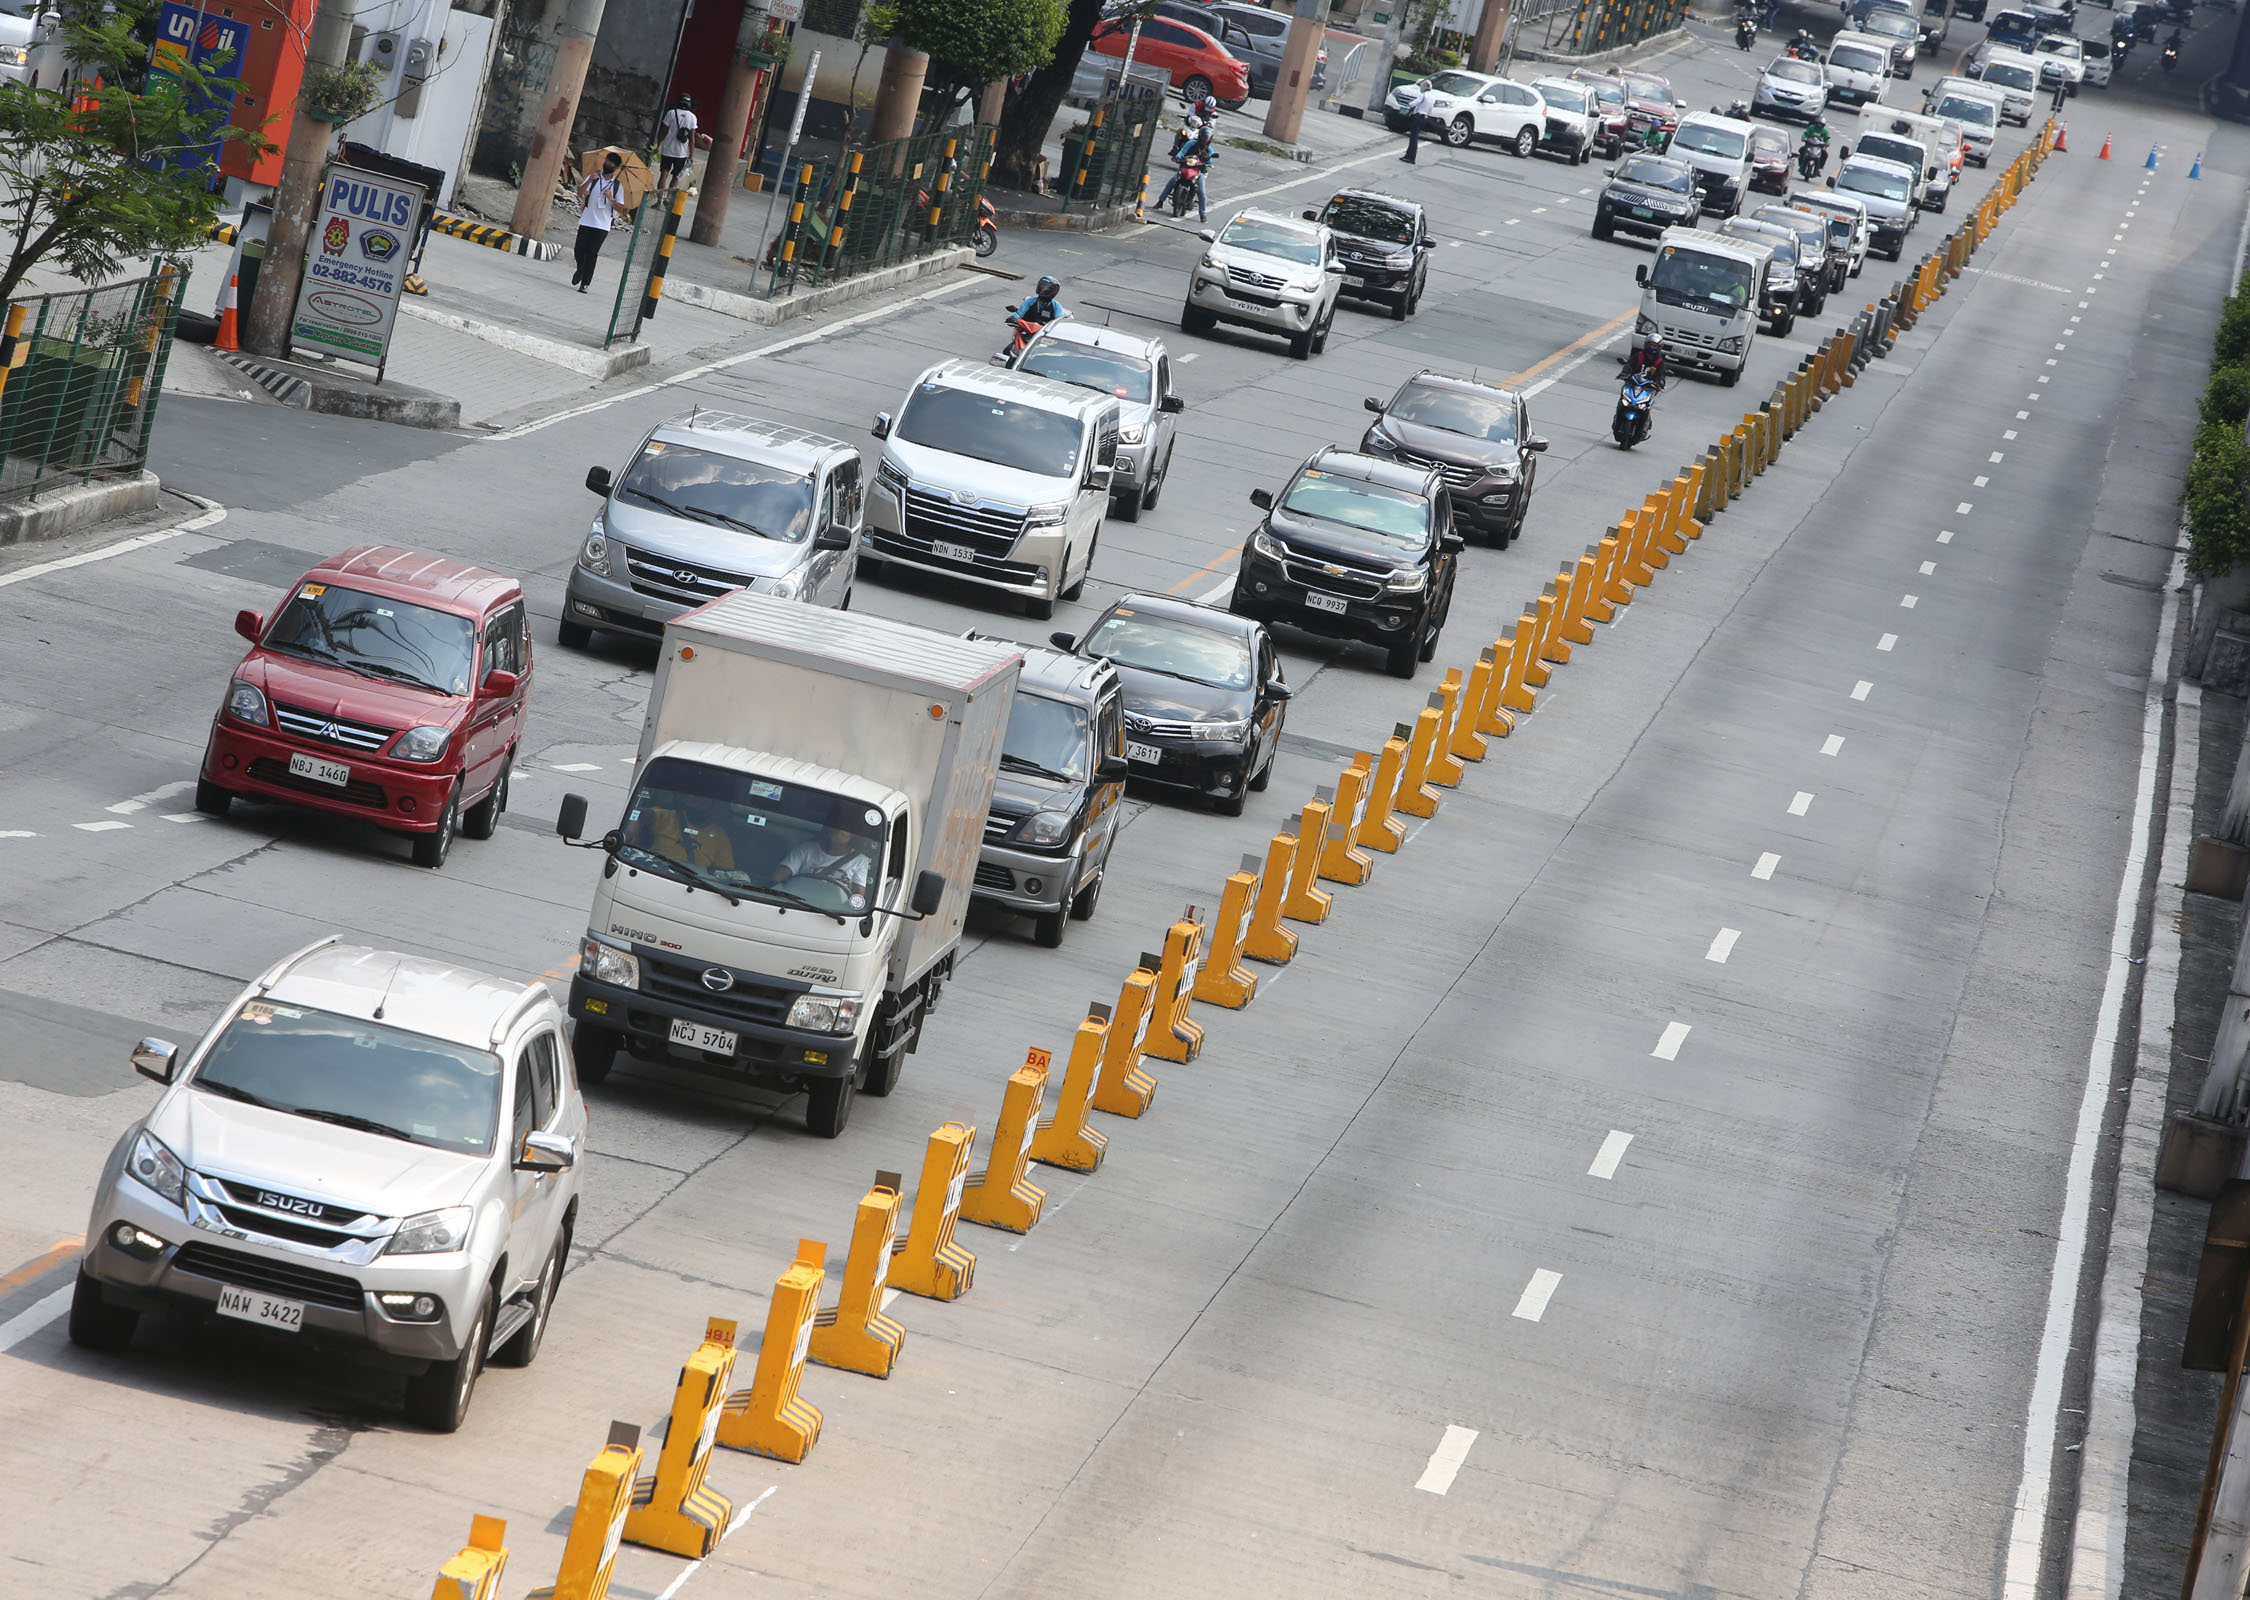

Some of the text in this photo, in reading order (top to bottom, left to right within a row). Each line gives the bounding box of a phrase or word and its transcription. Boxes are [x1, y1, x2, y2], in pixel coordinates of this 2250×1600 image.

[329, 179, 411, 226] PULIS
[312, 263, 393, 294] 02-882-4576
[319, 254, 363, 273] Emergency
[365, 266, 394, 280] Hotline
[312, 296, 377, 318] ASTROTEL
[1682, 302, 1709, 312] ISUZU
[952, 548, 974, 560] 1533
[1326, 599, 1346, 611] 9937
[1136, 745, 1158, 760] 3611
[291, 758, 347, 782] NBJ 1460
[611, 924, 682, 950] HINO 300
[787, 969, 837, 983] DUTRO
[672, 1024, 733, 1050] NCJ 5704
[257, 1191, 324, 1217] ISUZU
[260, 1301, 301, 1326] 3422
